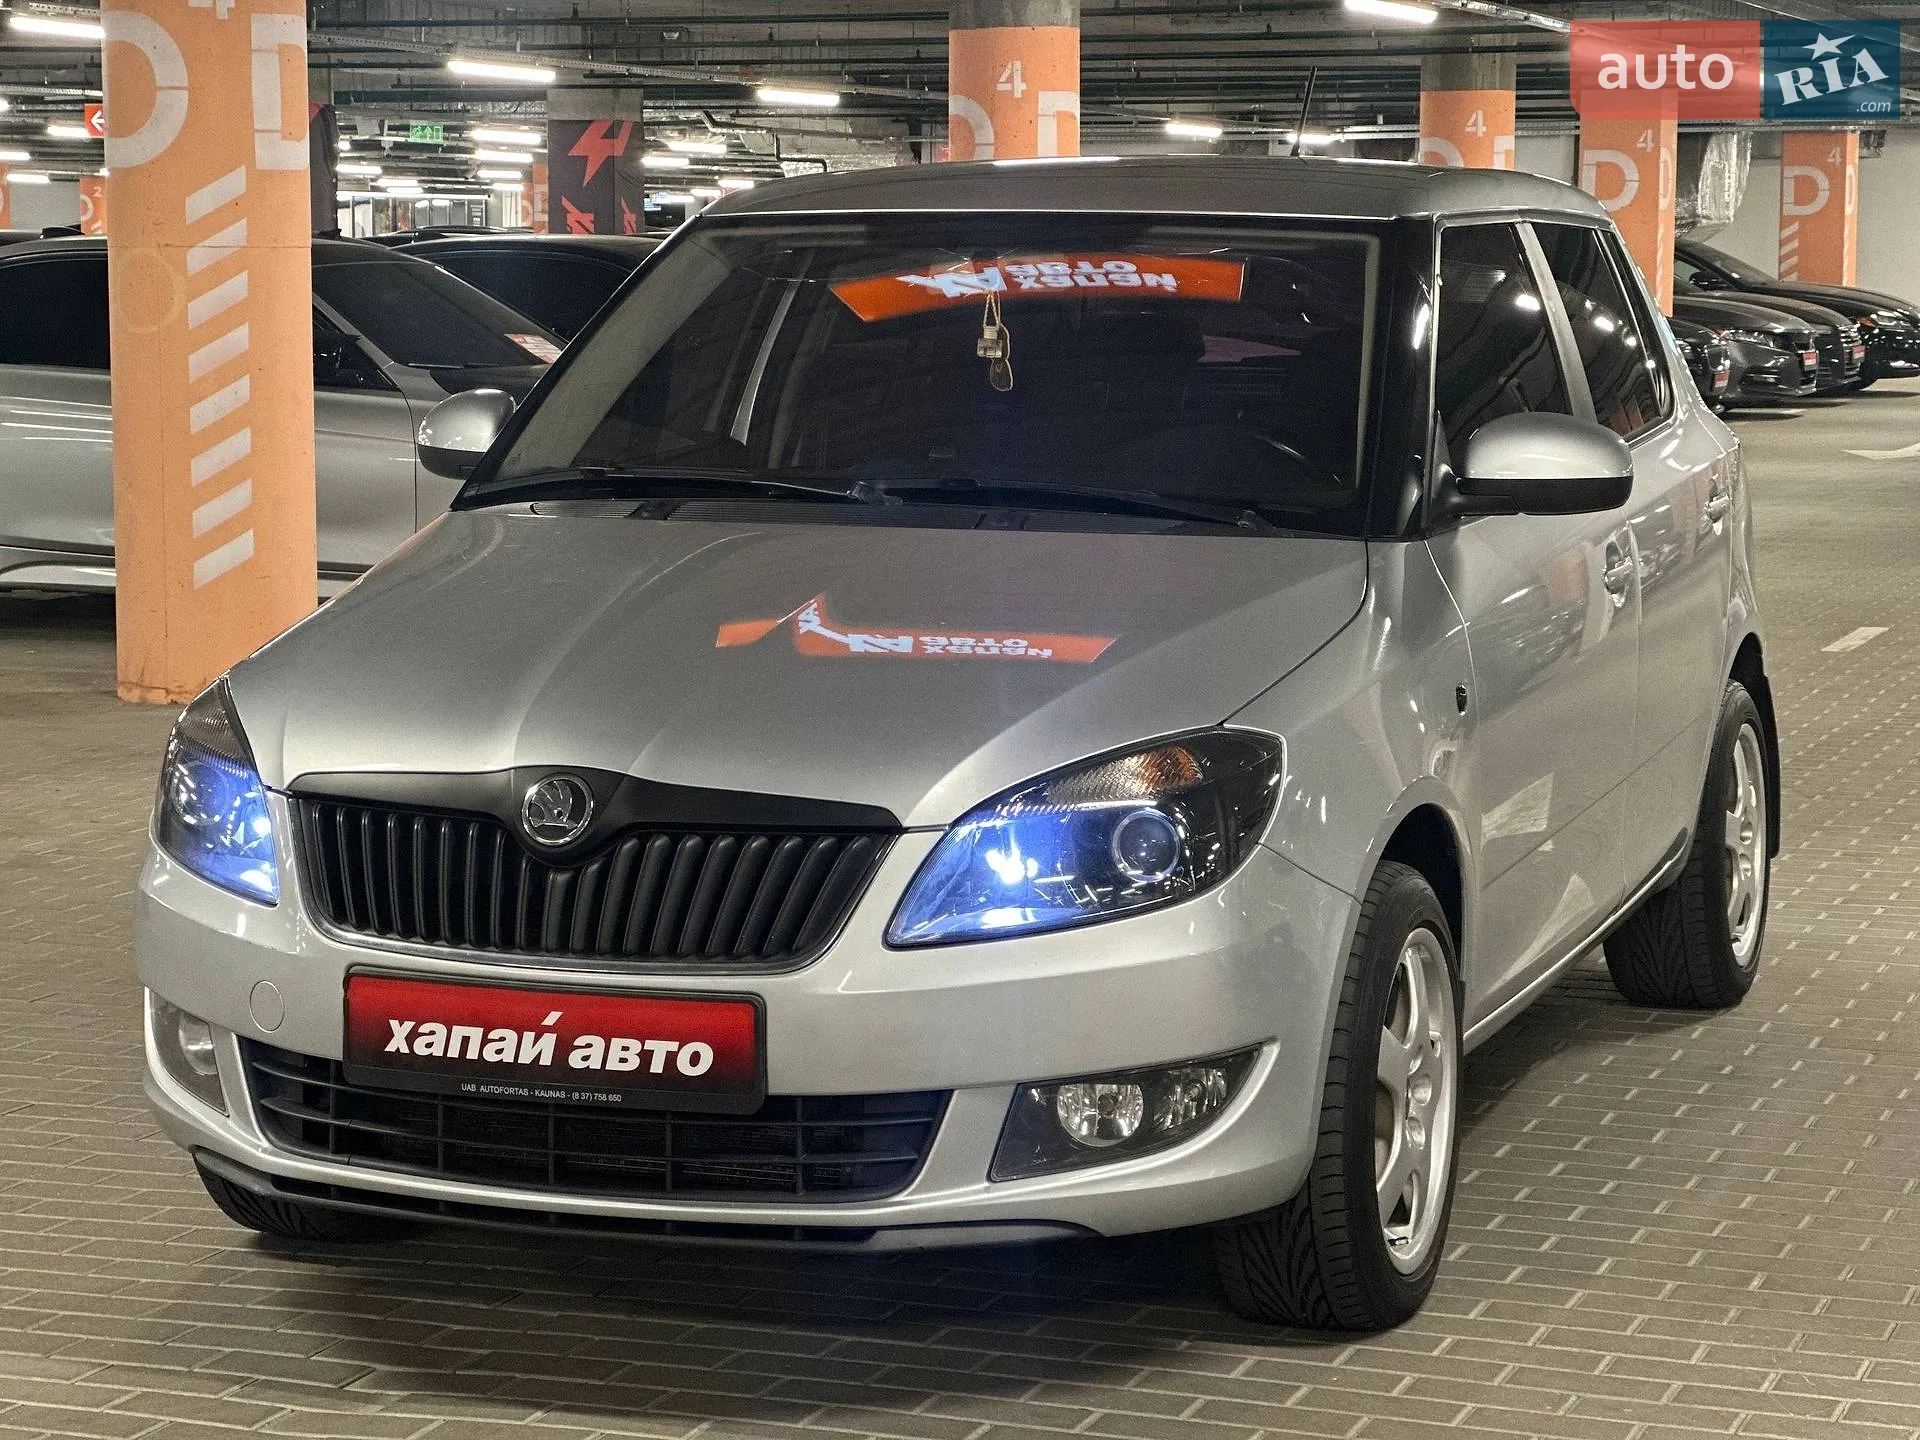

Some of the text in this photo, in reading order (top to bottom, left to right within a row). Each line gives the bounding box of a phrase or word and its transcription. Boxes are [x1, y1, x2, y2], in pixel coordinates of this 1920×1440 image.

[996, 61, 1027, 97] 4
[1465, 110, 1487, 137] 4
[1636, 128, 1655, 152] 4
[1827, 147, 1842, 166] 4
[1582, 149, 1640, 213] D
[1783, 165, 1831, 216] D
[384, 1011, 714, 1077] хапай авто
[461, 1083, 476, 1091] UAB
[480, 1085, 529, 1096] AUTOFORTAS
[534, 1089, 566, 1099] KAUNAS
[580, 1092, 593, 1101] 37)
